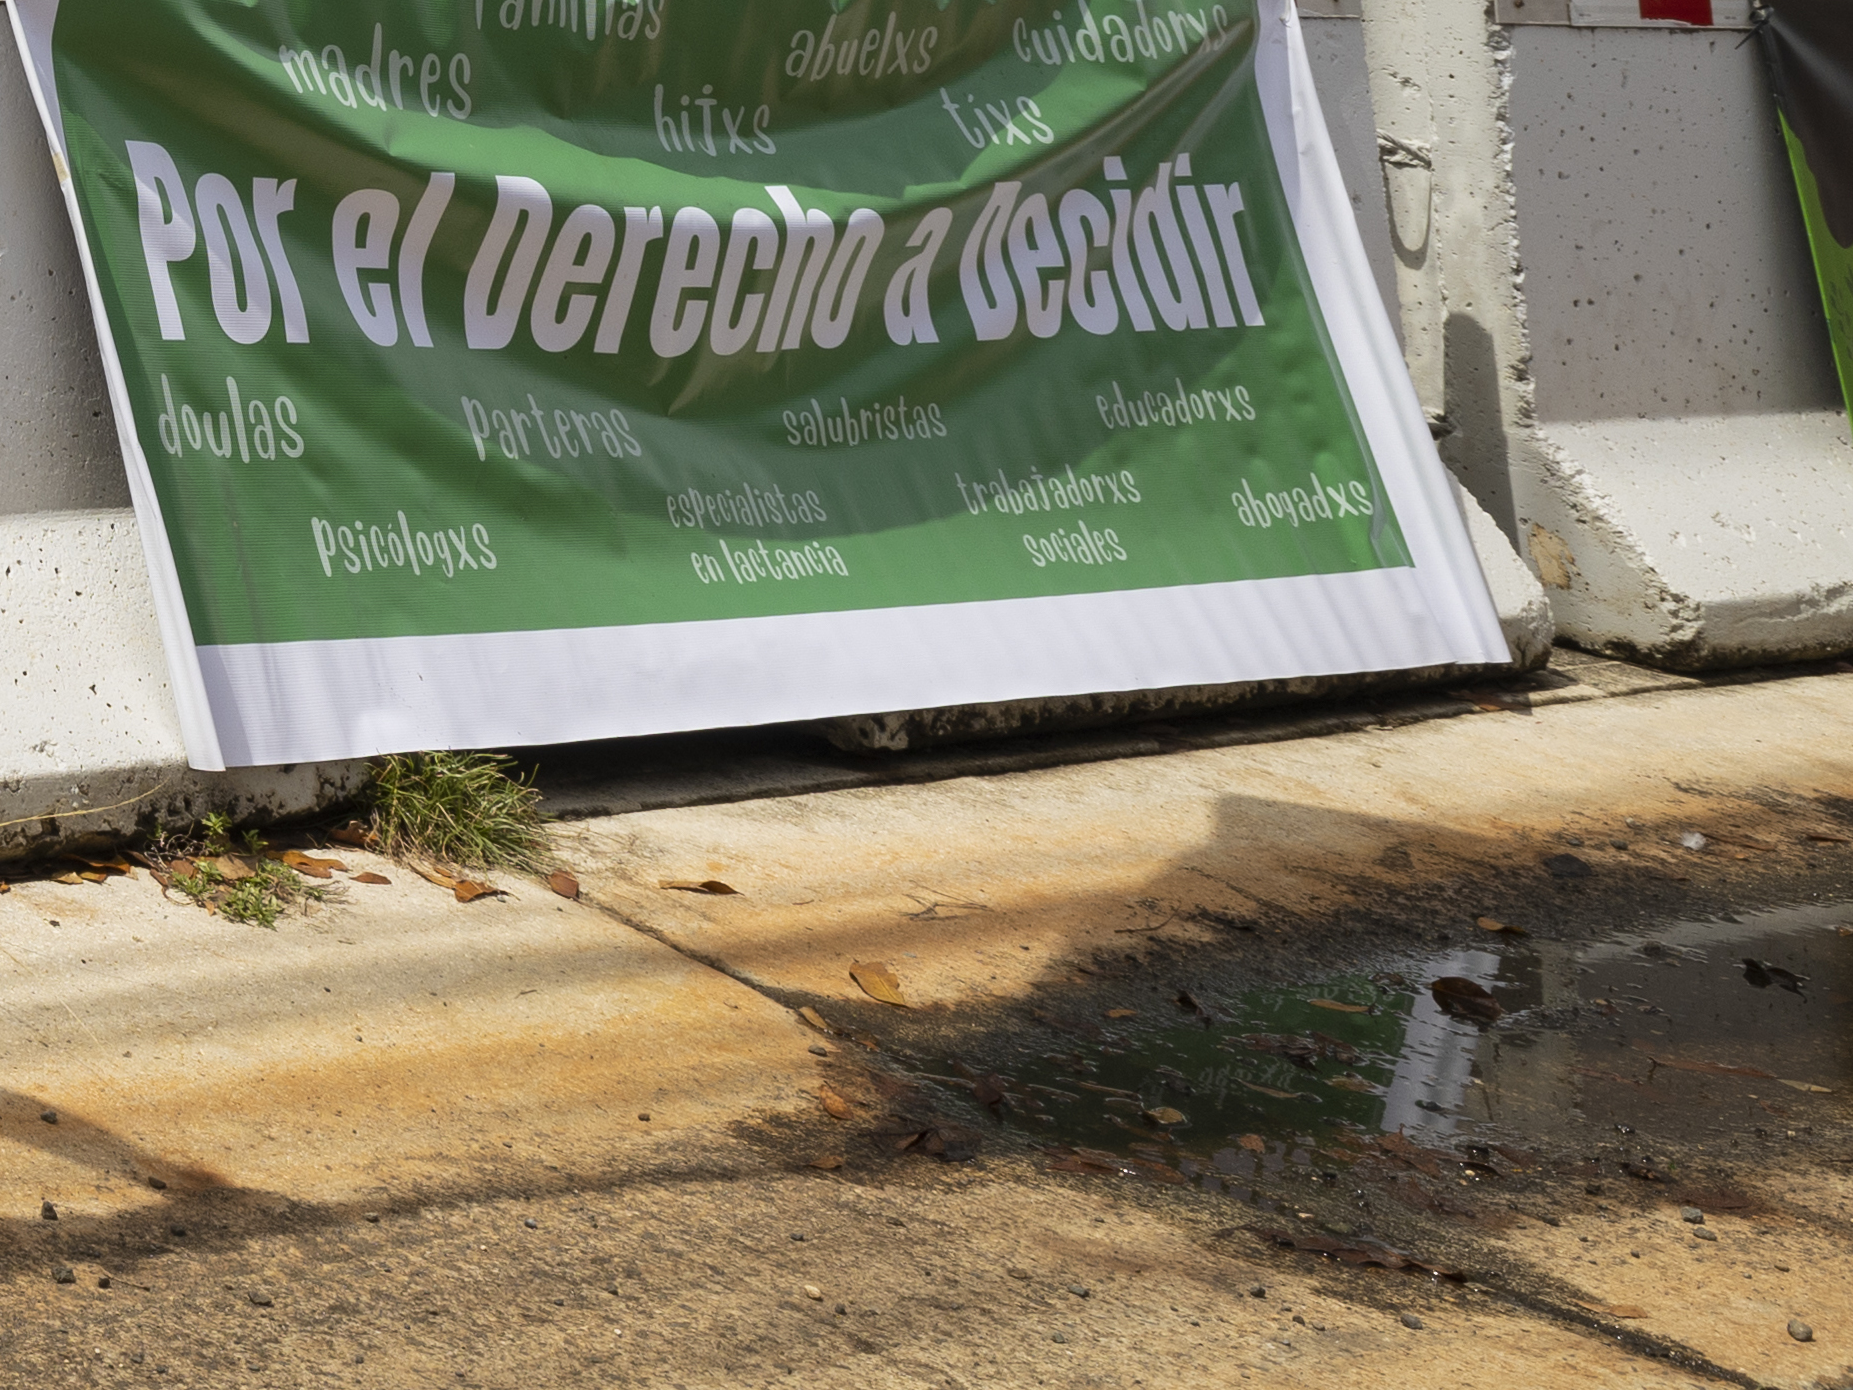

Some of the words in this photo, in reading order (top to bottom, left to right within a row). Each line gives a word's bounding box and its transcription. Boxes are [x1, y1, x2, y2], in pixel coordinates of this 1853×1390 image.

[279, 23, 473, 121] madres
[785, 13, 938, 81] abuelxs
[654, 83, 777, 158] hijxs
[125, 140, 310, 345] Por
[331, 172, 455, 348] el
[464, 175, 885, 359] Derecho
[884, 207, 953, 346] a
[959, 152, 1265, 343] Decidir
[158, 373, 304, 463] doulas
[783, 396, 947, 447] salubristas
[1096, 378, 1256, 431] educadorxs
[955, 463, 1142, 516] trabajadorxs
[1232, 472, 1374, 529] abogadxs
[690, 550, 726, 585] en
[718, 538, 849, 585] lactancia
[1023, 520, 1127, 568] sociales
